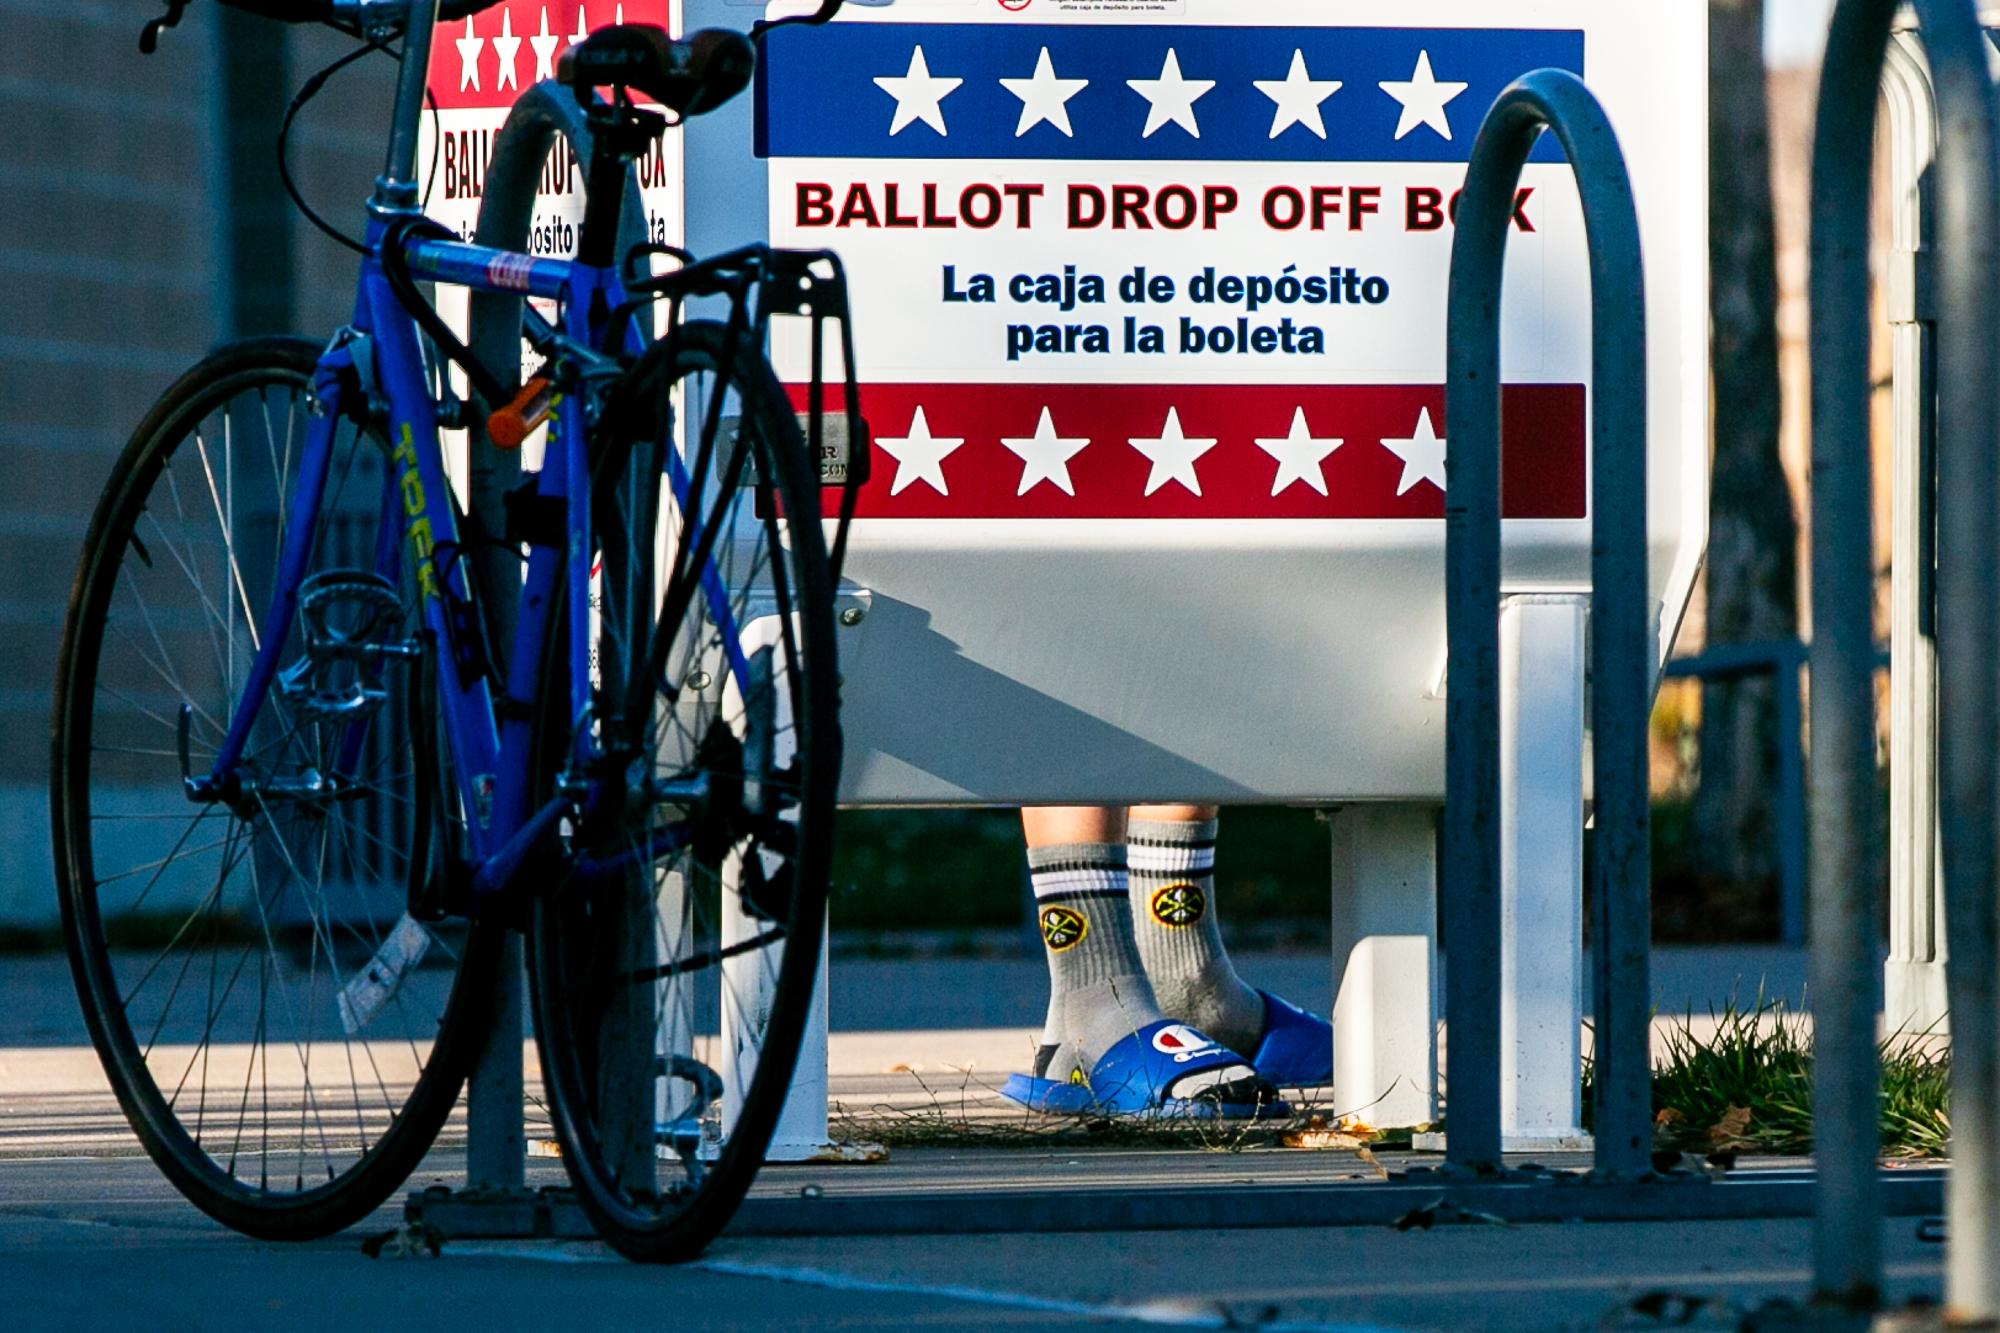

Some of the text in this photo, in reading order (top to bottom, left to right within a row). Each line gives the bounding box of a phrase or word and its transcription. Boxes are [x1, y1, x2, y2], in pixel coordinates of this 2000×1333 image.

[796, 182, 1044, 230] BALLOT
[1067, 183, 1238, 230] DROP
[1261, 184, 1381, 231] OFF
[942, 262, 1390, 312] La caja de depósito
[1006, 316, 1325, 362] para la boleta
